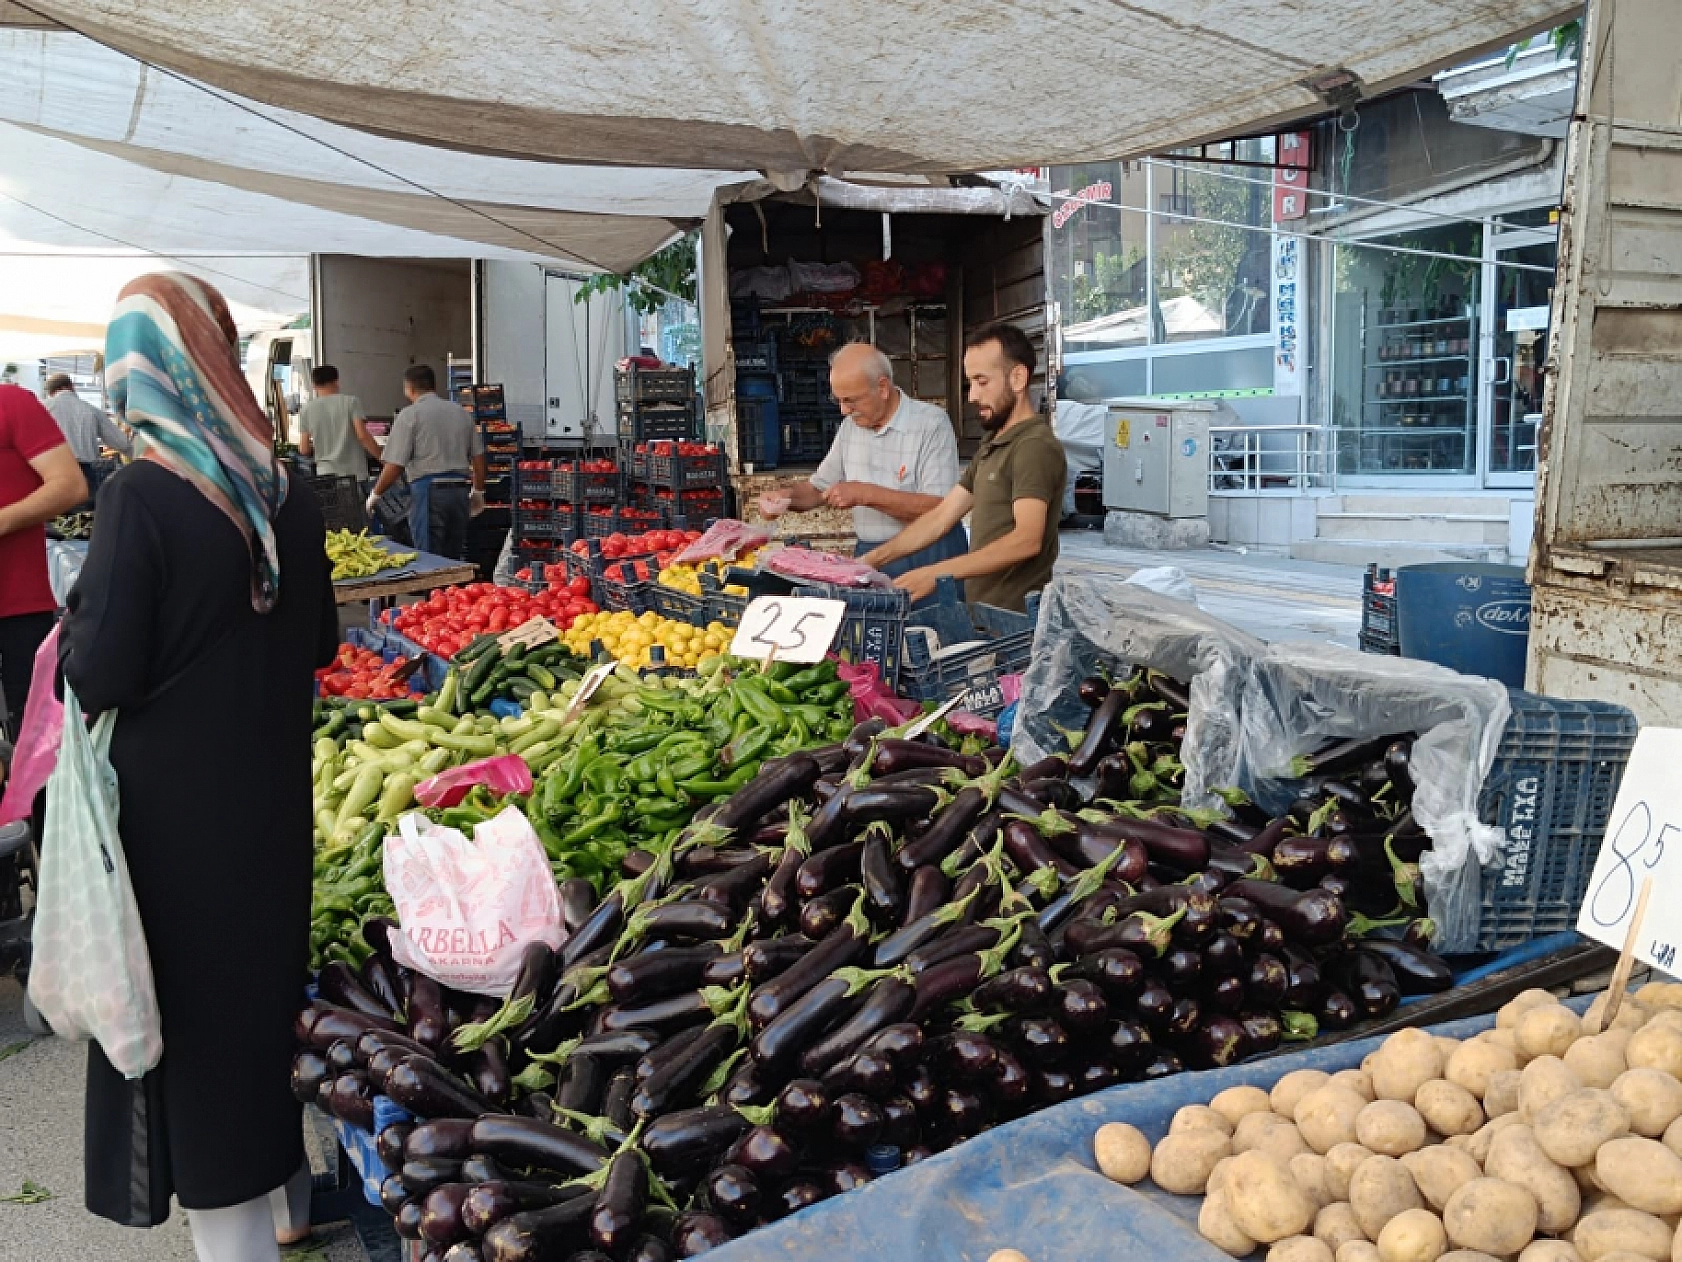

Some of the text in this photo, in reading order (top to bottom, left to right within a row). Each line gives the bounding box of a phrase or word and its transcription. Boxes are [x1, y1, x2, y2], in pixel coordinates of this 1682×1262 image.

[751, 601, 826, 650] 25
[1591, 801, 1682, 926] 85
[428, 957, 497, 965] AKARNA
